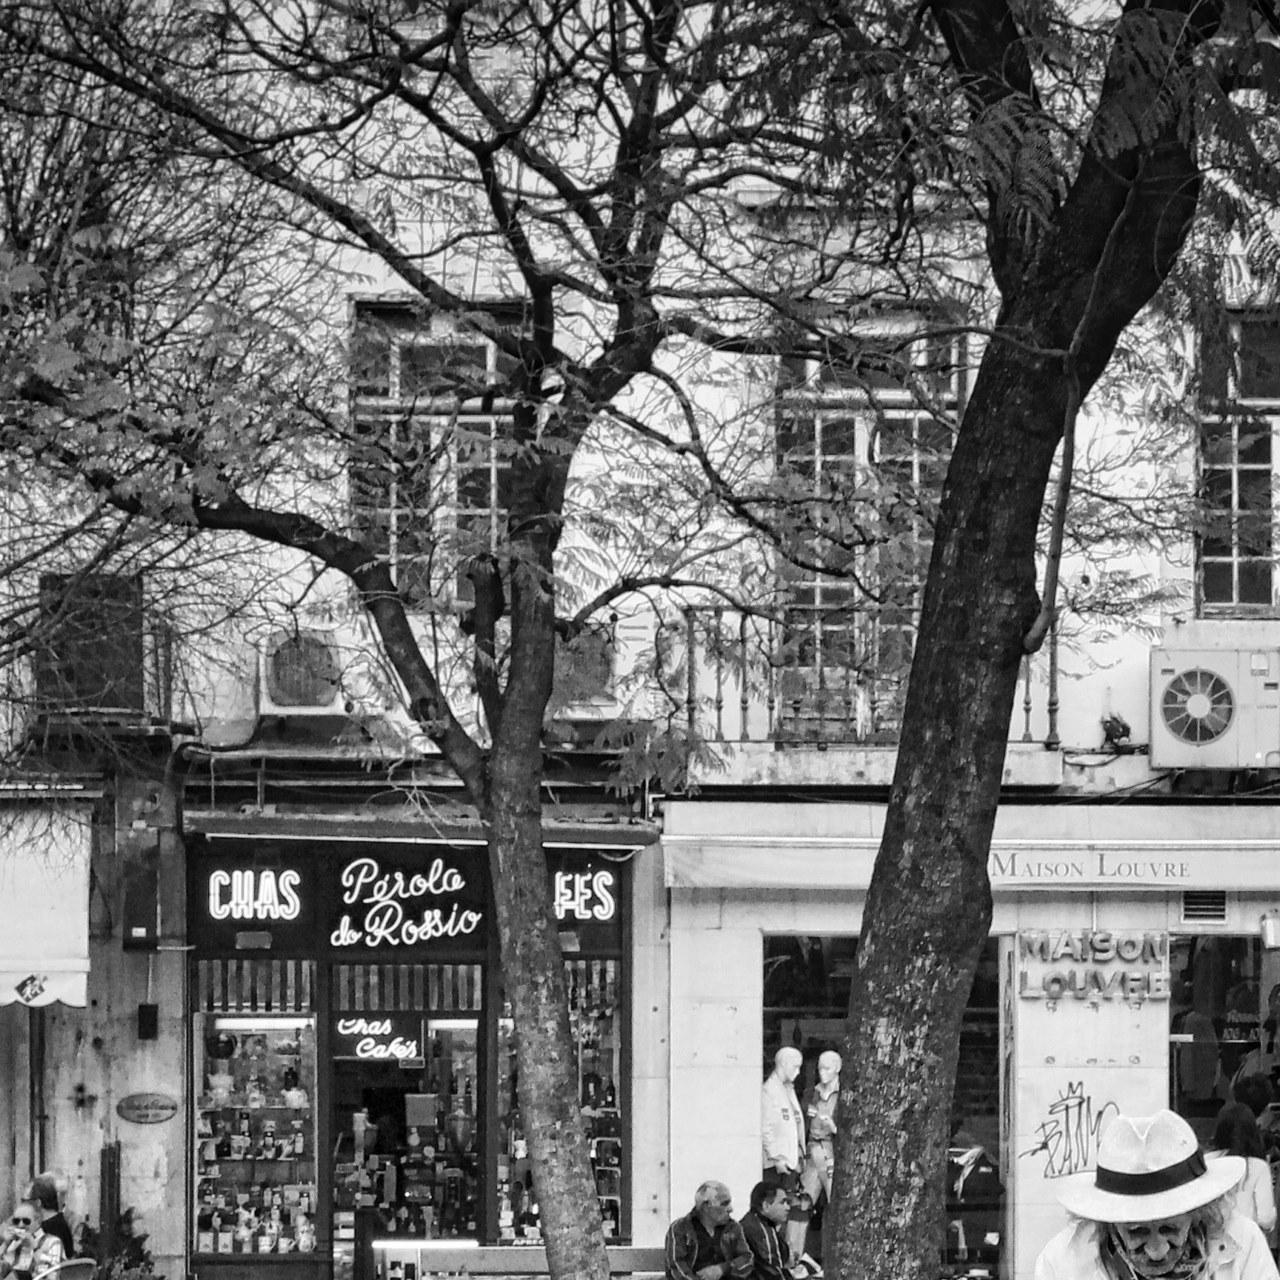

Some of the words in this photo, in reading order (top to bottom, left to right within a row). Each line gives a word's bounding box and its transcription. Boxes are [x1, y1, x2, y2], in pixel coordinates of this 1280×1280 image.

[342, 858, 465, 904] Pérola
[991, 853, 1084, 878] MAISON
[1097, 853, 1191, 878] LOUVRE
[330, 914, 362, 946] do
[365, 900, 483, 947] Rossio
[1020, 932, 1170, 964] MAISON
[1020, 969, 1170, 1000] LOUVRE
